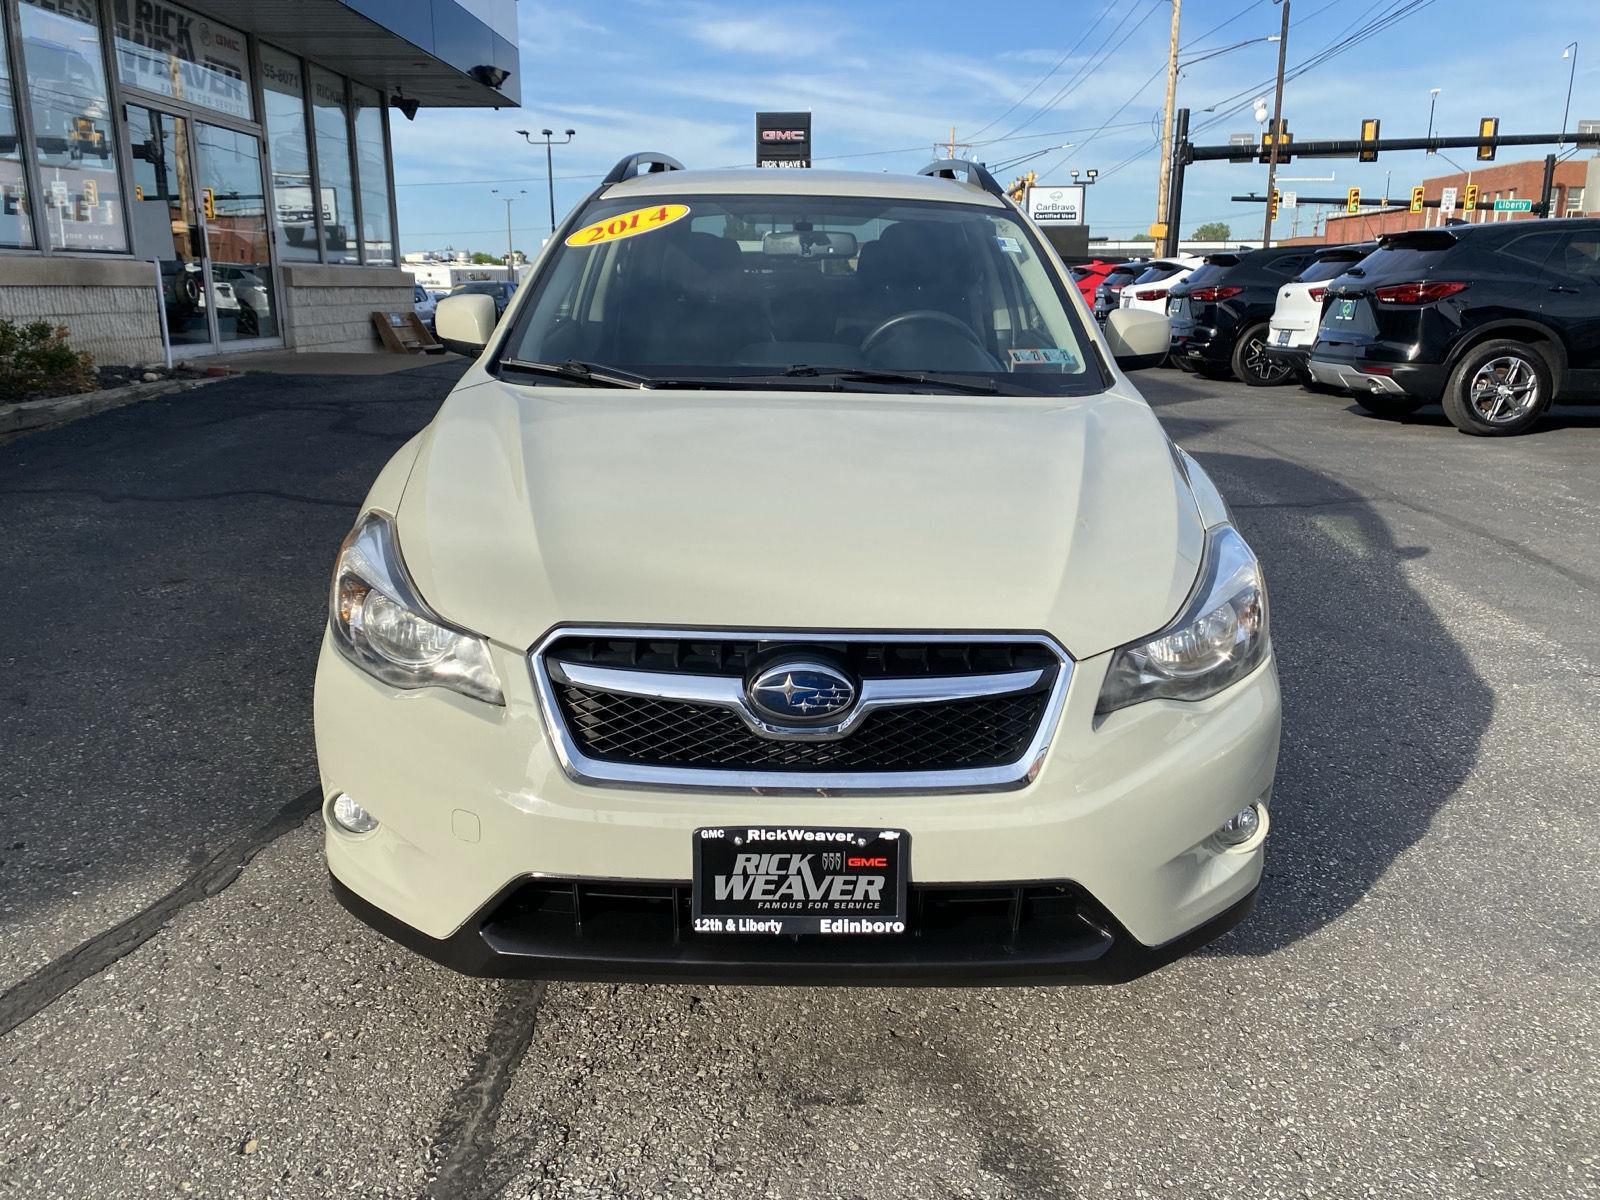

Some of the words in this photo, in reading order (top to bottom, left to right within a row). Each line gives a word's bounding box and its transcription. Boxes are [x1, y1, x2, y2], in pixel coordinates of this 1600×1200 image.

[134, 0, 194, 46] RICK
[215, 34, 240, 52] GMC
[762, 130, 805, 140] GMC
[761, 160, 778, 168] RICK
[779, 160, 806, 168] WEAVER
[1036, 203, 1075, 211] CarBravo
[1498, 200, 1527, 211] Liberty
[586, 206, 669, 243] 2014
[700, 829, 725, 839] GMC
[732, 853, 816, 876] RICK
[847, 857, 888, 867] GMC
[714, 874, 886, 901] WEAVER
[694, 918, 722, 932] 12th
[725, 918, 736, 932] &
[738, 918, 782, 935] Liberty
[820, 918, 905, 933] Edinboro
